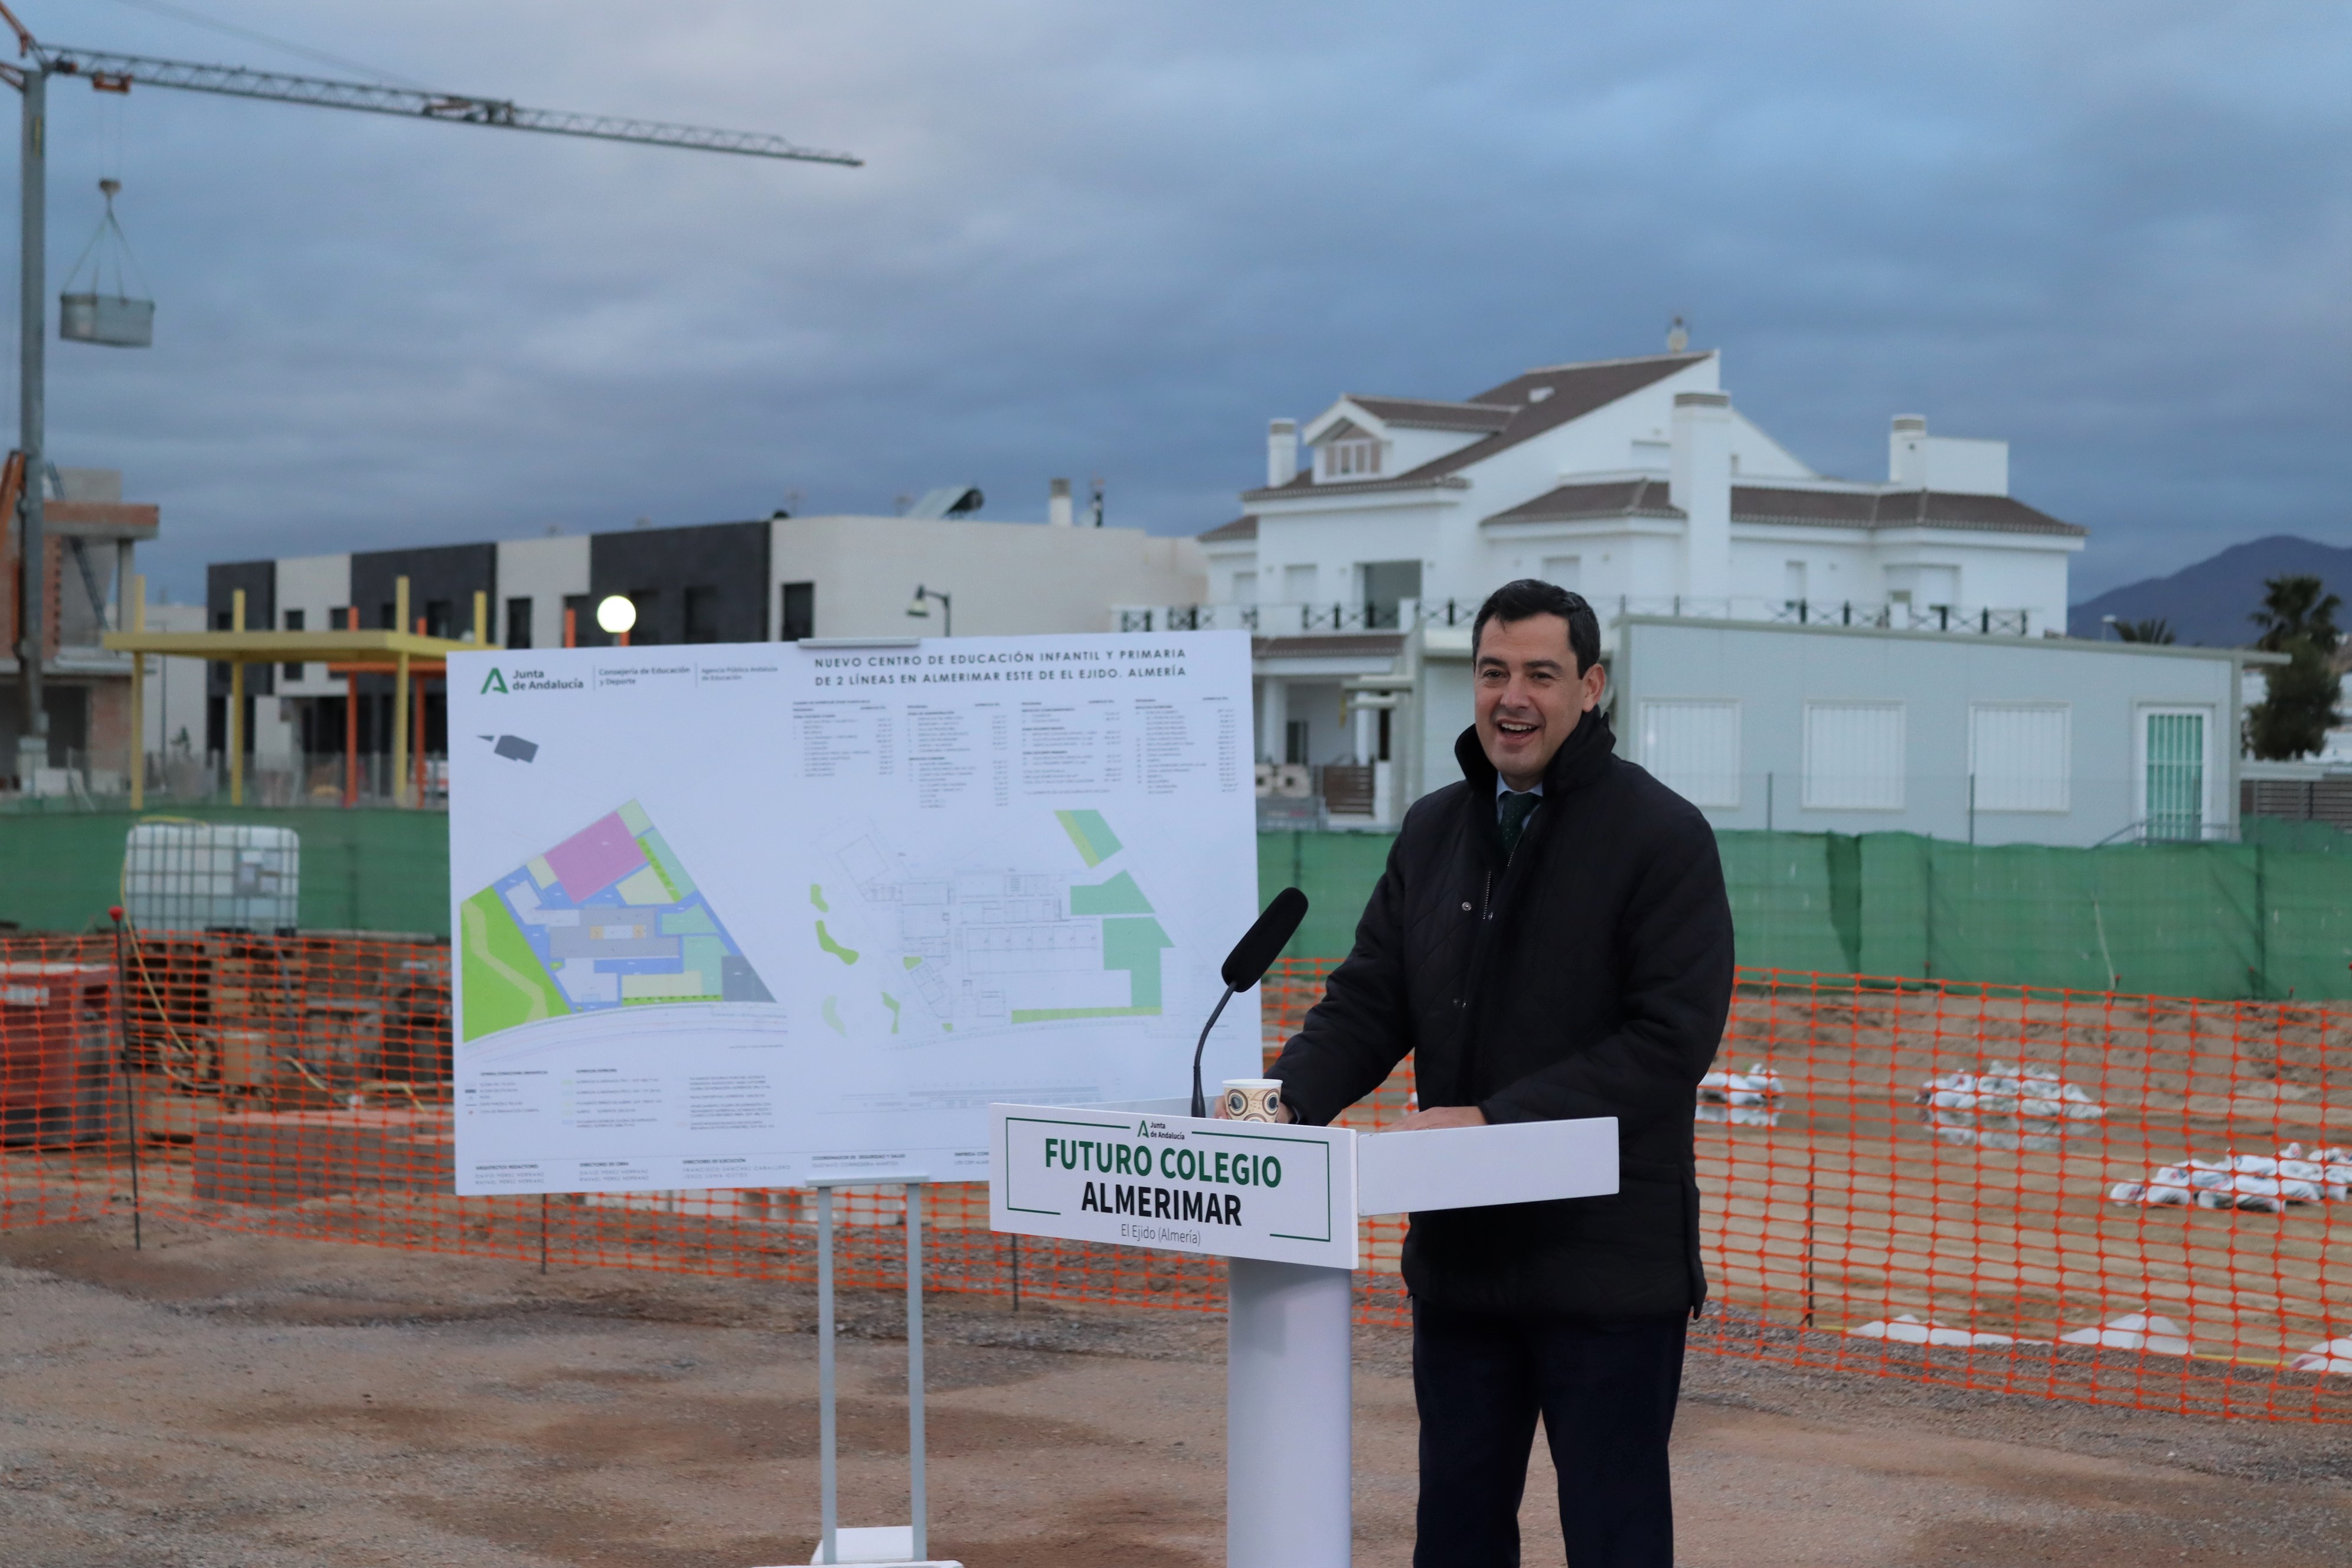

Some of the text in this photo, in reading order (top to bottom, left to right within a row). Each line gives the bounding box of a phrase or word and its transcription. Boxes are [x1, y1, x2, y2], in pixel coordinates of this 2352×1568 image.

[815, 649, 1186, 667] NUEVO CENTRO DE EDUCACIÓN INFANTIL Y PRIMARIA
[513, 670, 544, 679] Junta
[651, 666, 691, 674] Educación
[815, 676, 831, 685] DE
[837, 676, 844, 685] 2
[850, 673, 894, 685] LÍNEAS
[901, 674, 916, 684] EN
[923, 672, 1001, 683] ALMERIMAR
[1006, 671, 1033, 681] ESTE
[1039, 670, 1055, 680] DE
[1061, 670, 1074, 680] EL
[1128, 664, 1186, 677] ALMERÍA
[513, 678, 584, 690] de Andalucía
[1158, 1132, 1185, 1140] Andalucía
[1045, 1138, 1282, 1188] FUTURO COLEGIO
[1081, 1181, 1242, 1226] ALMERIMAR
[1121, 1224, 1201, 1246] El Ejido (Almería)
